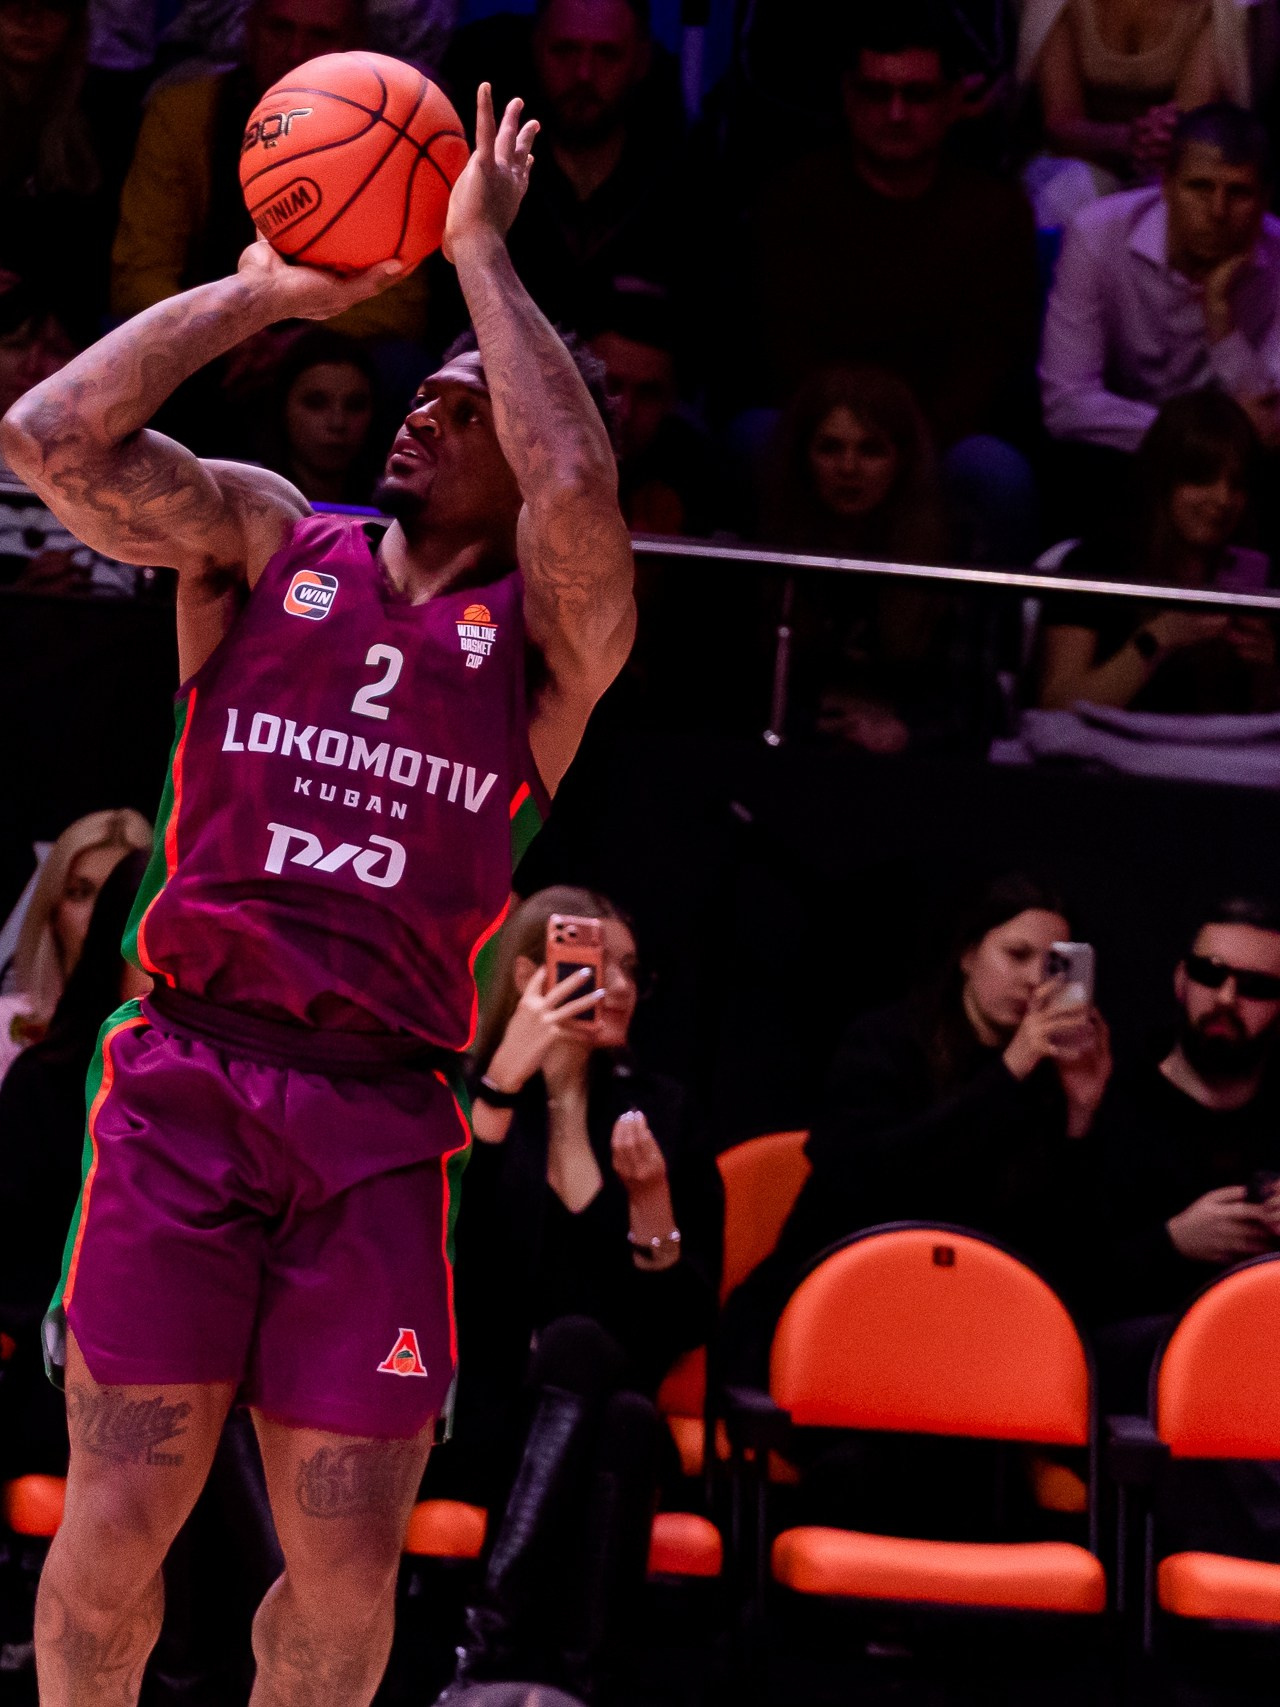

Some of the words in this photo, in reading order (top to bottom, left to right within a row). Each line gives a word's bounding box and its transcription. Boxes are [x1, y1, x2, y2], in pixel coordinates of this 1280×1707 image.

[299, 586, 333, 605] WIN
[457, 623, 497, 642] WINLINE
[460, 636, 493, 656] BASKET
[465, 652, 484, 669] CUP
[350, 643, 404, 721] 2
[221, 708, 499, 814] LOKOMOTIV
[293, 776, 408, 821] KUBAN
